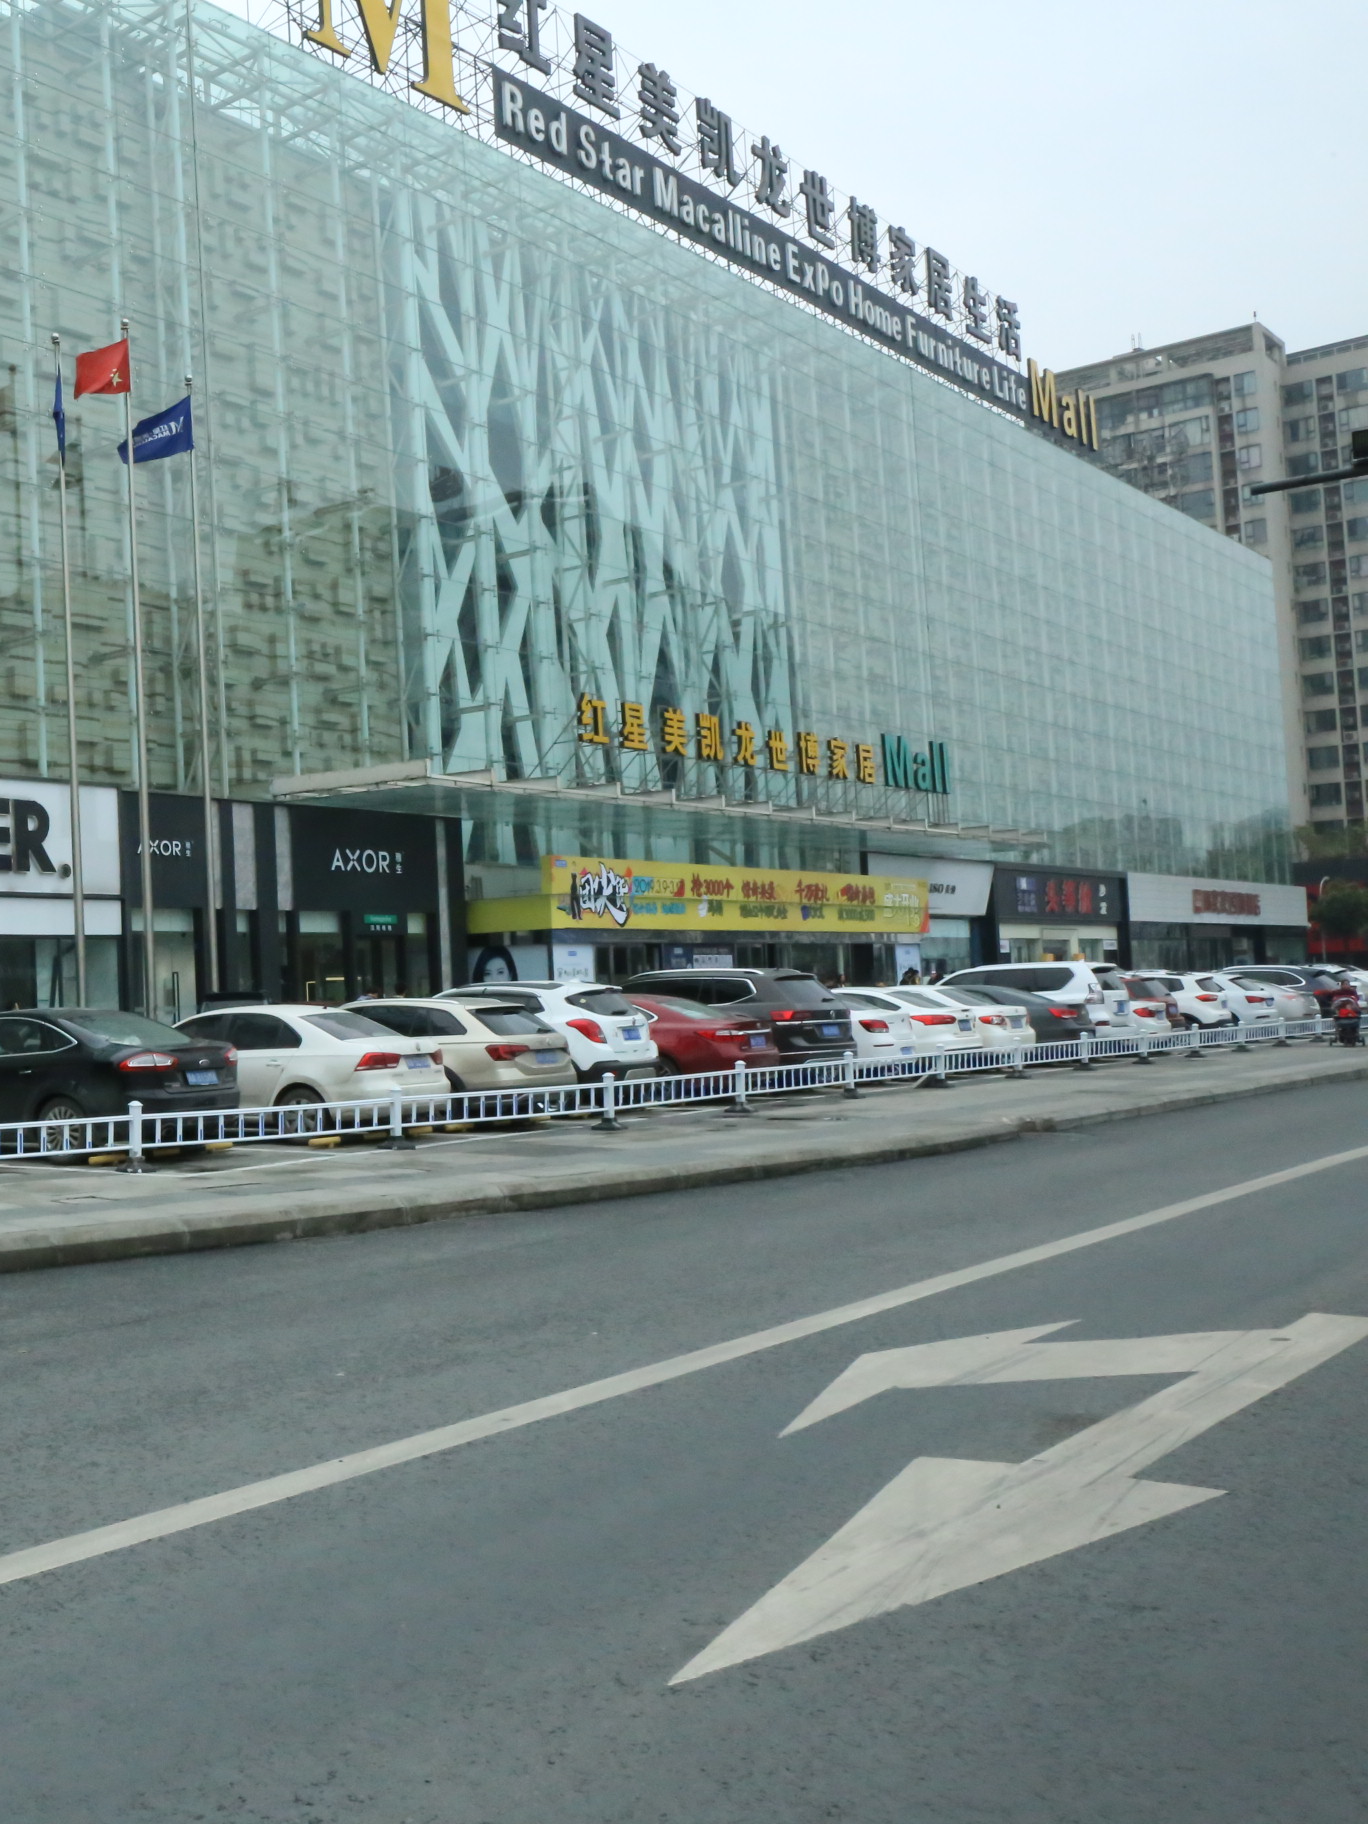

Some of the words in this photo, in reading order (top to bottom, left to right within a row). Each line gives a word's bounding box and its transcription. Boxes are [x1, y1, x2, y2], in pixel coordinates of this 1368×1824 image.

[498, 0, 1021, 362] 红星美凯龙世博家居生活
[1027, 357, 1098, 450] Mall
[501, 81, 567, 156] Red
[577, 125, 644, 195] Star
[653, 167, 781, 270] Macalline
[848, 280, 902, 341] Home
[905, 315, 990, 390] Furniture
[992, 366, 1026, 410] Life
[578, 693, 875, 783] 红星美凯龙世博家居
[880, 733, 950, 794] Mall
[331, 848, 390, 873] AXOR
